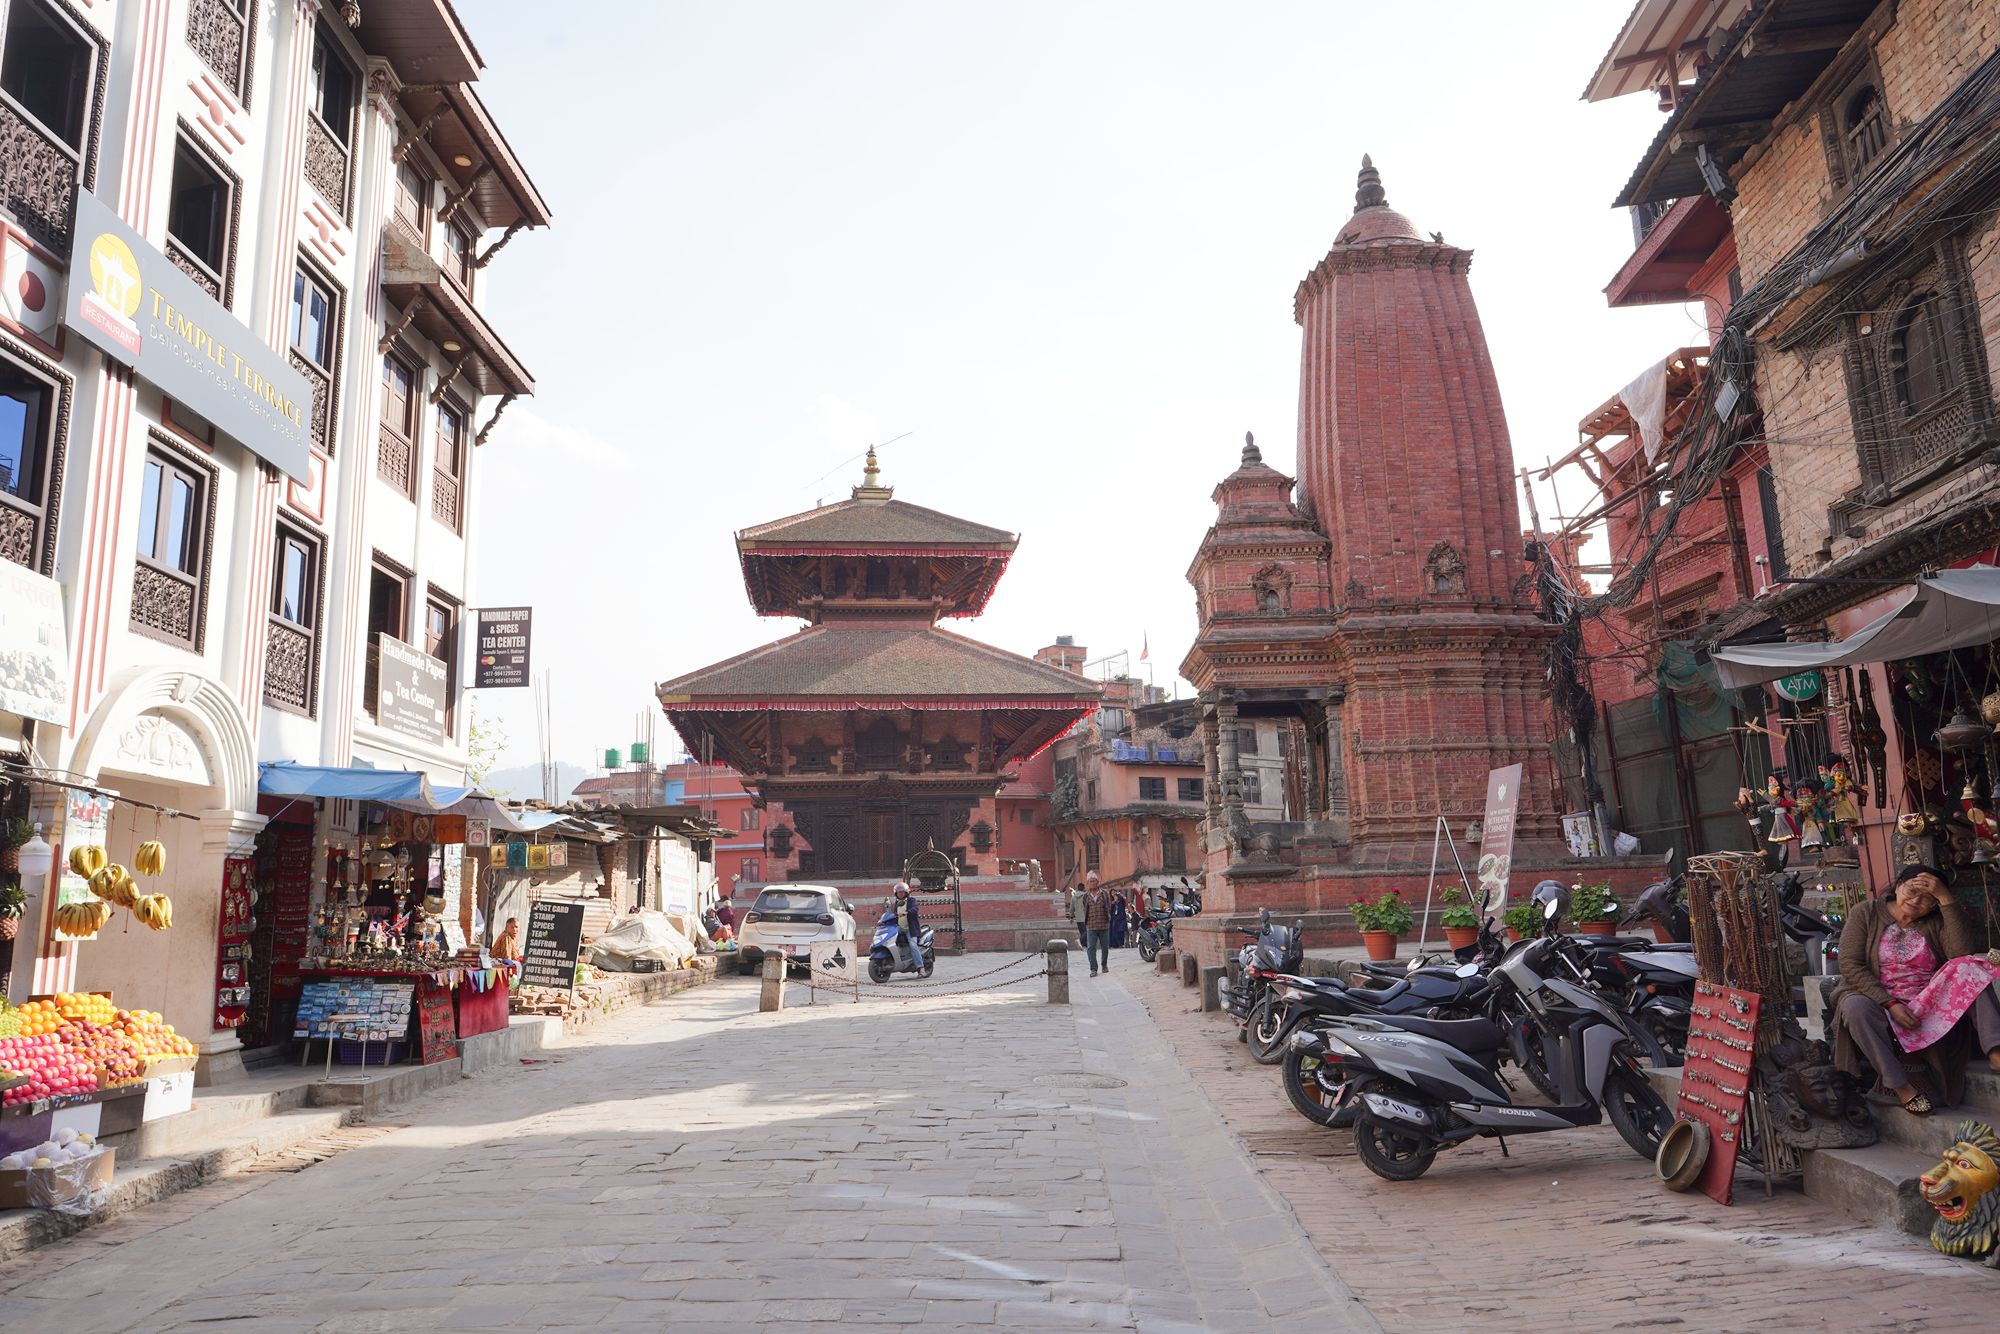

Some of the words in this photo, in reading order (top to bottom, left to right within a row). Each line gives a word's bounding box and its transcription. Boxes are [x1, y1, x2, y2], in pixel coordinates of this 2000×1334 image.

[85, 305, 137, 346] RESTAURANT
[150, 323, 204, 373] Delicious
[149, 287, 227, 369] TEMPLE
[231, 352, 302, 430] TERRACE
[481, 611, 511, 621] HANDMADE
[511, 610, 528, 620] PAPER
[490, 626, 495, 634] &
[496, 624, 519, 634] SPICES
[482, 637, 496, 648] TEA
[497, 636, 526, 648] CENTER
[383, 637, 425, 671] Handmade
[425, 657, 446, 680] Paper
[411, 670, 419, 686] &
[1787, 679, 1817, 690] ATM
[395, 681, 410, 701] Tea
[410, 688, 435, 710] Center
[552, 905, 569, 914] CARD
[534, 912, 555, 921] STAMP
[532, 921, 555, 930] SPICES
[531, 930, 542, 938] TEA
[530, 939, 557, 948] SAFFRON
[528, 948, 551, 957] PRAYER
[552, 950, 567, 958] FLAG
[527, 957, 556, 967] GREETING
[557, 960, 574, 968] CARD
[525, 966, 541, 974] NOTE
[542, 967, 560, 975] BOOK
[524, 974, 550, 984] SINGING
[550, 977, 569, 986] BOWL
[1498, 1108, 1537, 1117] HONDA
